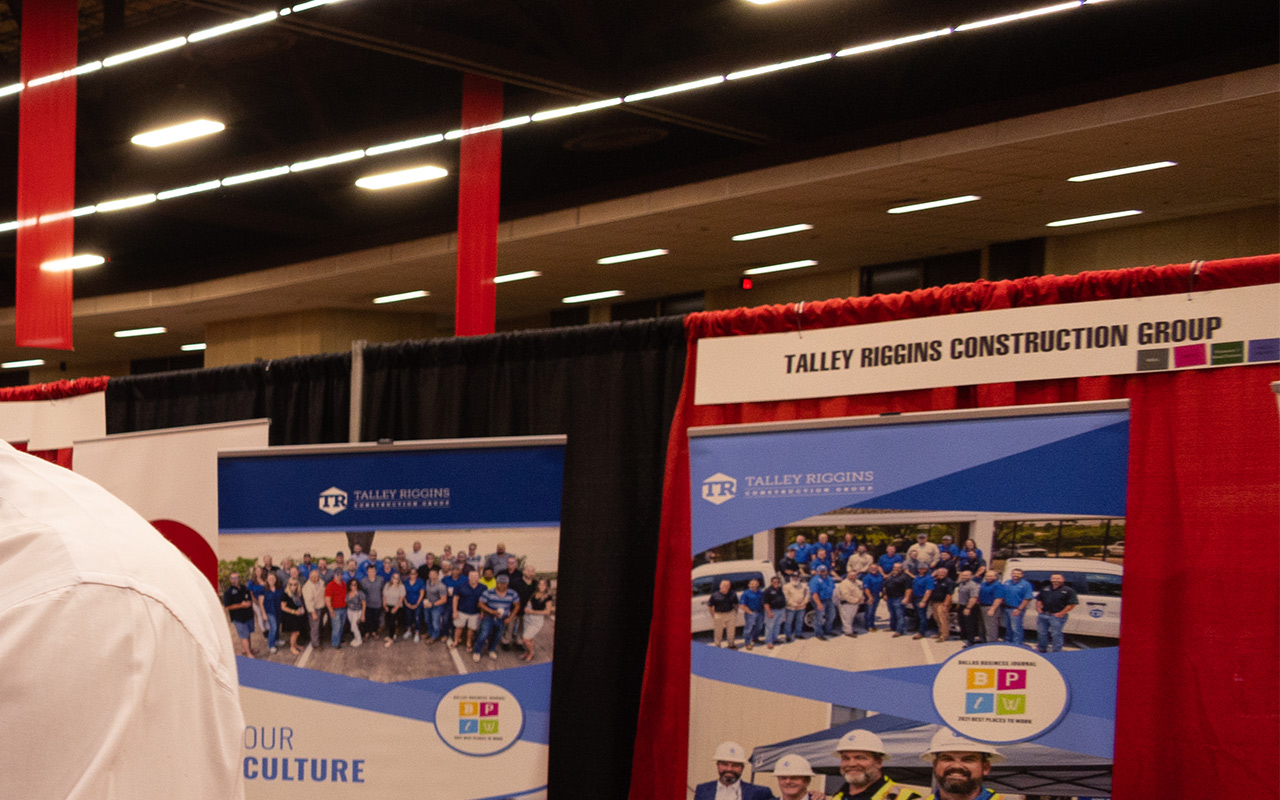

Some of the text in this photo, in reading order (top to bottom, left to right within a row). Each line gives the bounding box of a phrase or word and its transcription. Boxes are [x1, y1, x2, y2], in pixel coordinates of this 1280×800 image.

[784, 316, 1223, 374] TALLEY RIGGINS CONSTRUCTION GROUP
[745, 474, 803, 486] TALLEY
[805, 471, 874, 484] RIGGINS
[353, 489, 397, 500] TALLEY
[399, 487, 451, 499] RIGGINS
[973, 671, 1019, 687] B P
[244, 725, 294, 750] OUR
[243, 756, 366, 783] CULTURE
